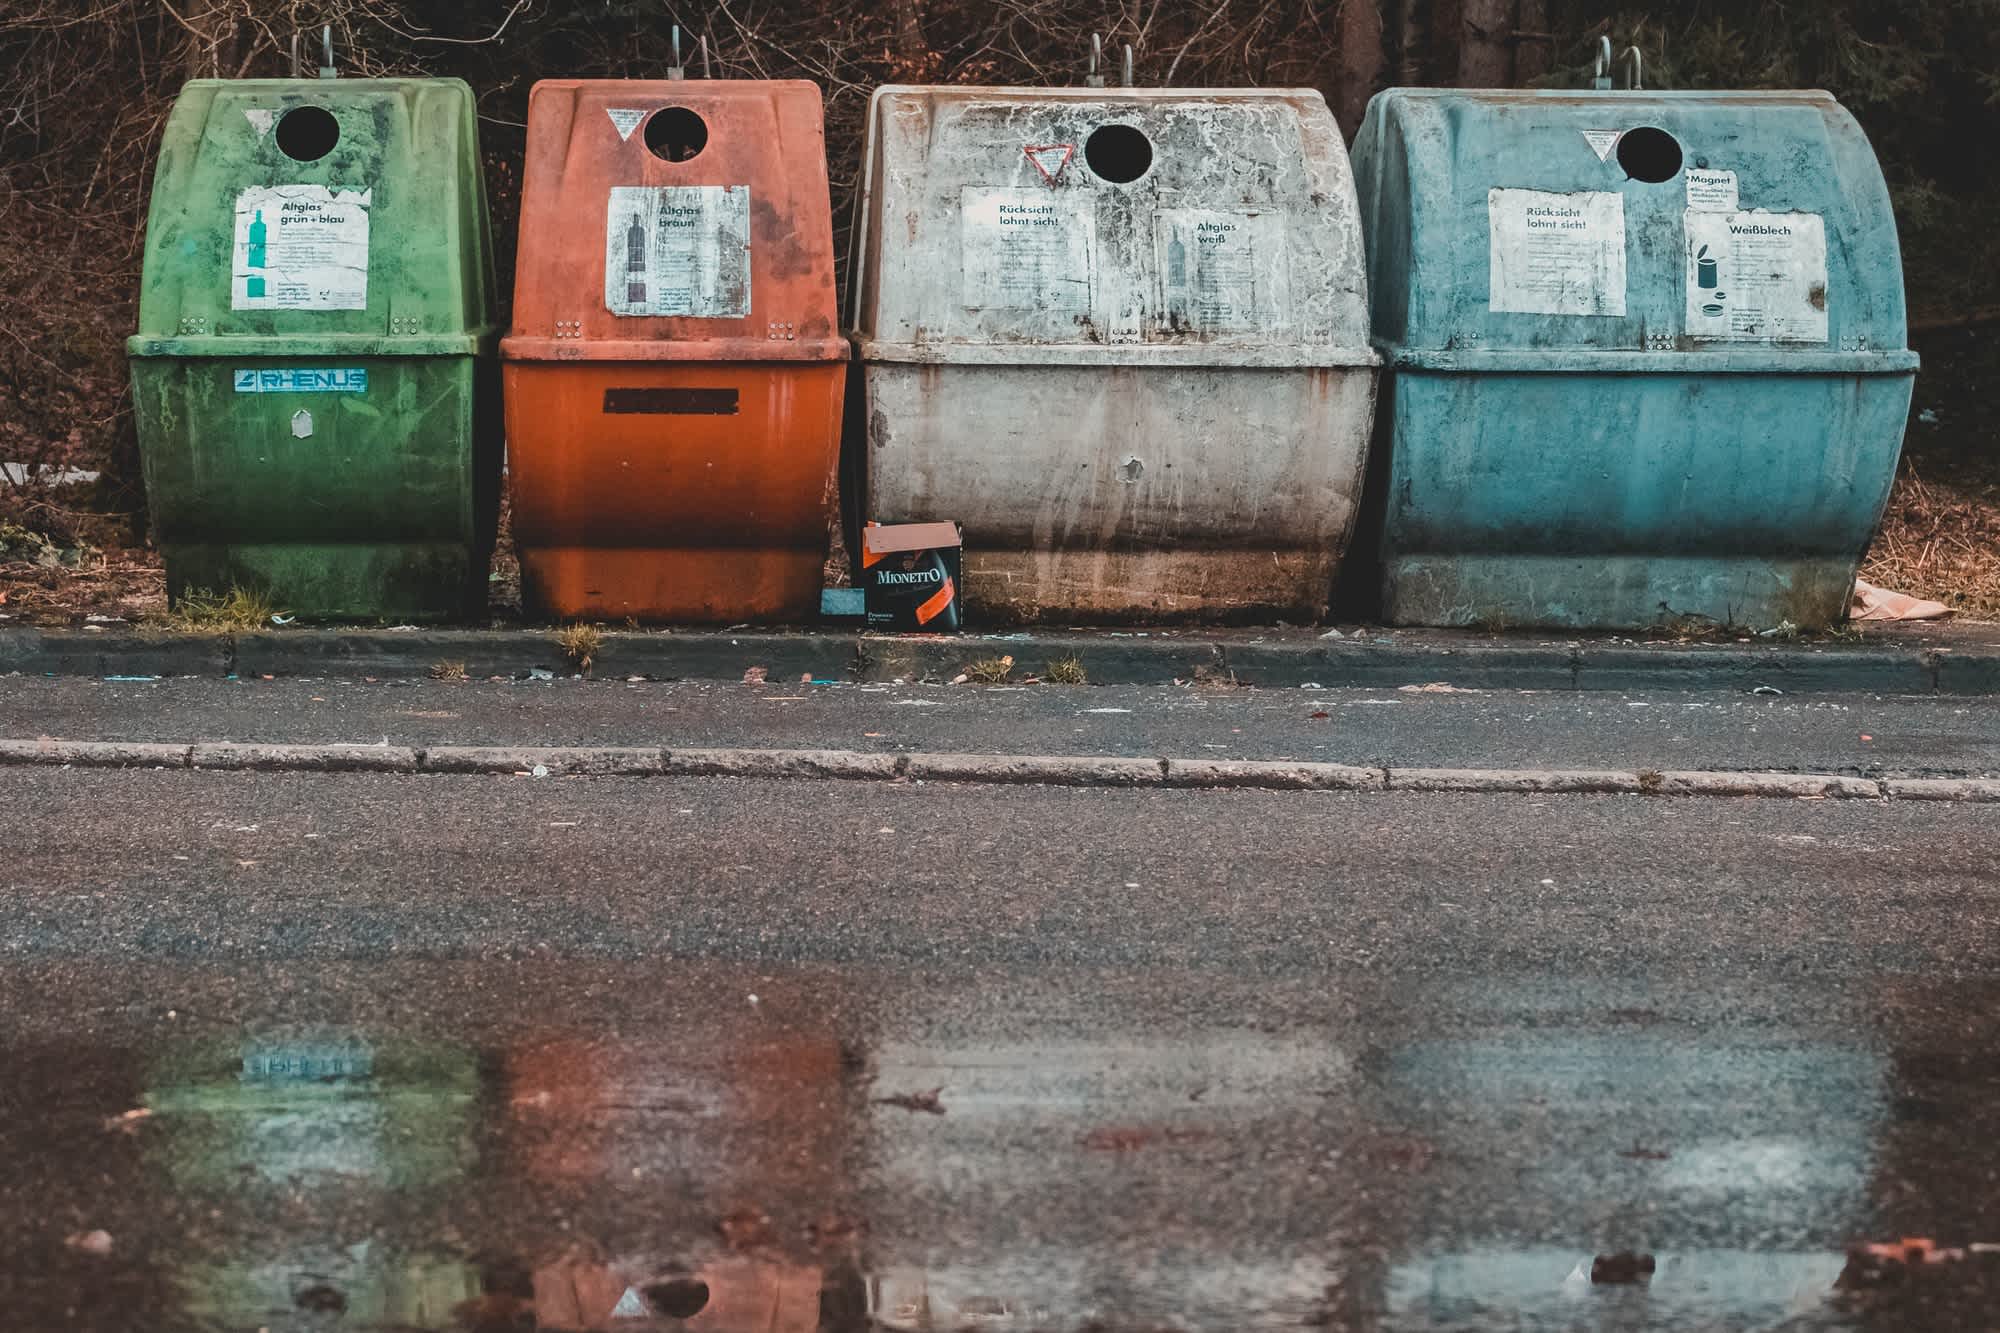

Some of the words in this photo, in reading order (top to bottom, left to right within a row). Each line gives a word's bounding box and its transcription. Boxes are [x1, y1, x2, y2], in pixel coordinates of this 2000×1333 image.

[1690, 175, 1731, 185] Magnet
[281, 203, 322, 213] Altglas
[660, 206, 701, 216] Altglas
[999, 205, 1053, 214] Rücksicht
[1526, 207, 1581, 217] Rücksicht
[281, 214, 308, 225] grün
[319, 214, 345, 224] blau
[659, 218, 695, 228] braun
[999, 216, 1029, 225] lohnt
[1033, 217, 1058, 226] sich!
[1527, 219, 1557, 229] lohnt
[1561, 220, 1587, 229] sich!
[1197, 221, 1237, 233] Altglas
[1729, 225, 1792, 236] Weißblech
[1197, 234, 1226, 244] weiß
[261, 373, 366, 388] RHENUS
